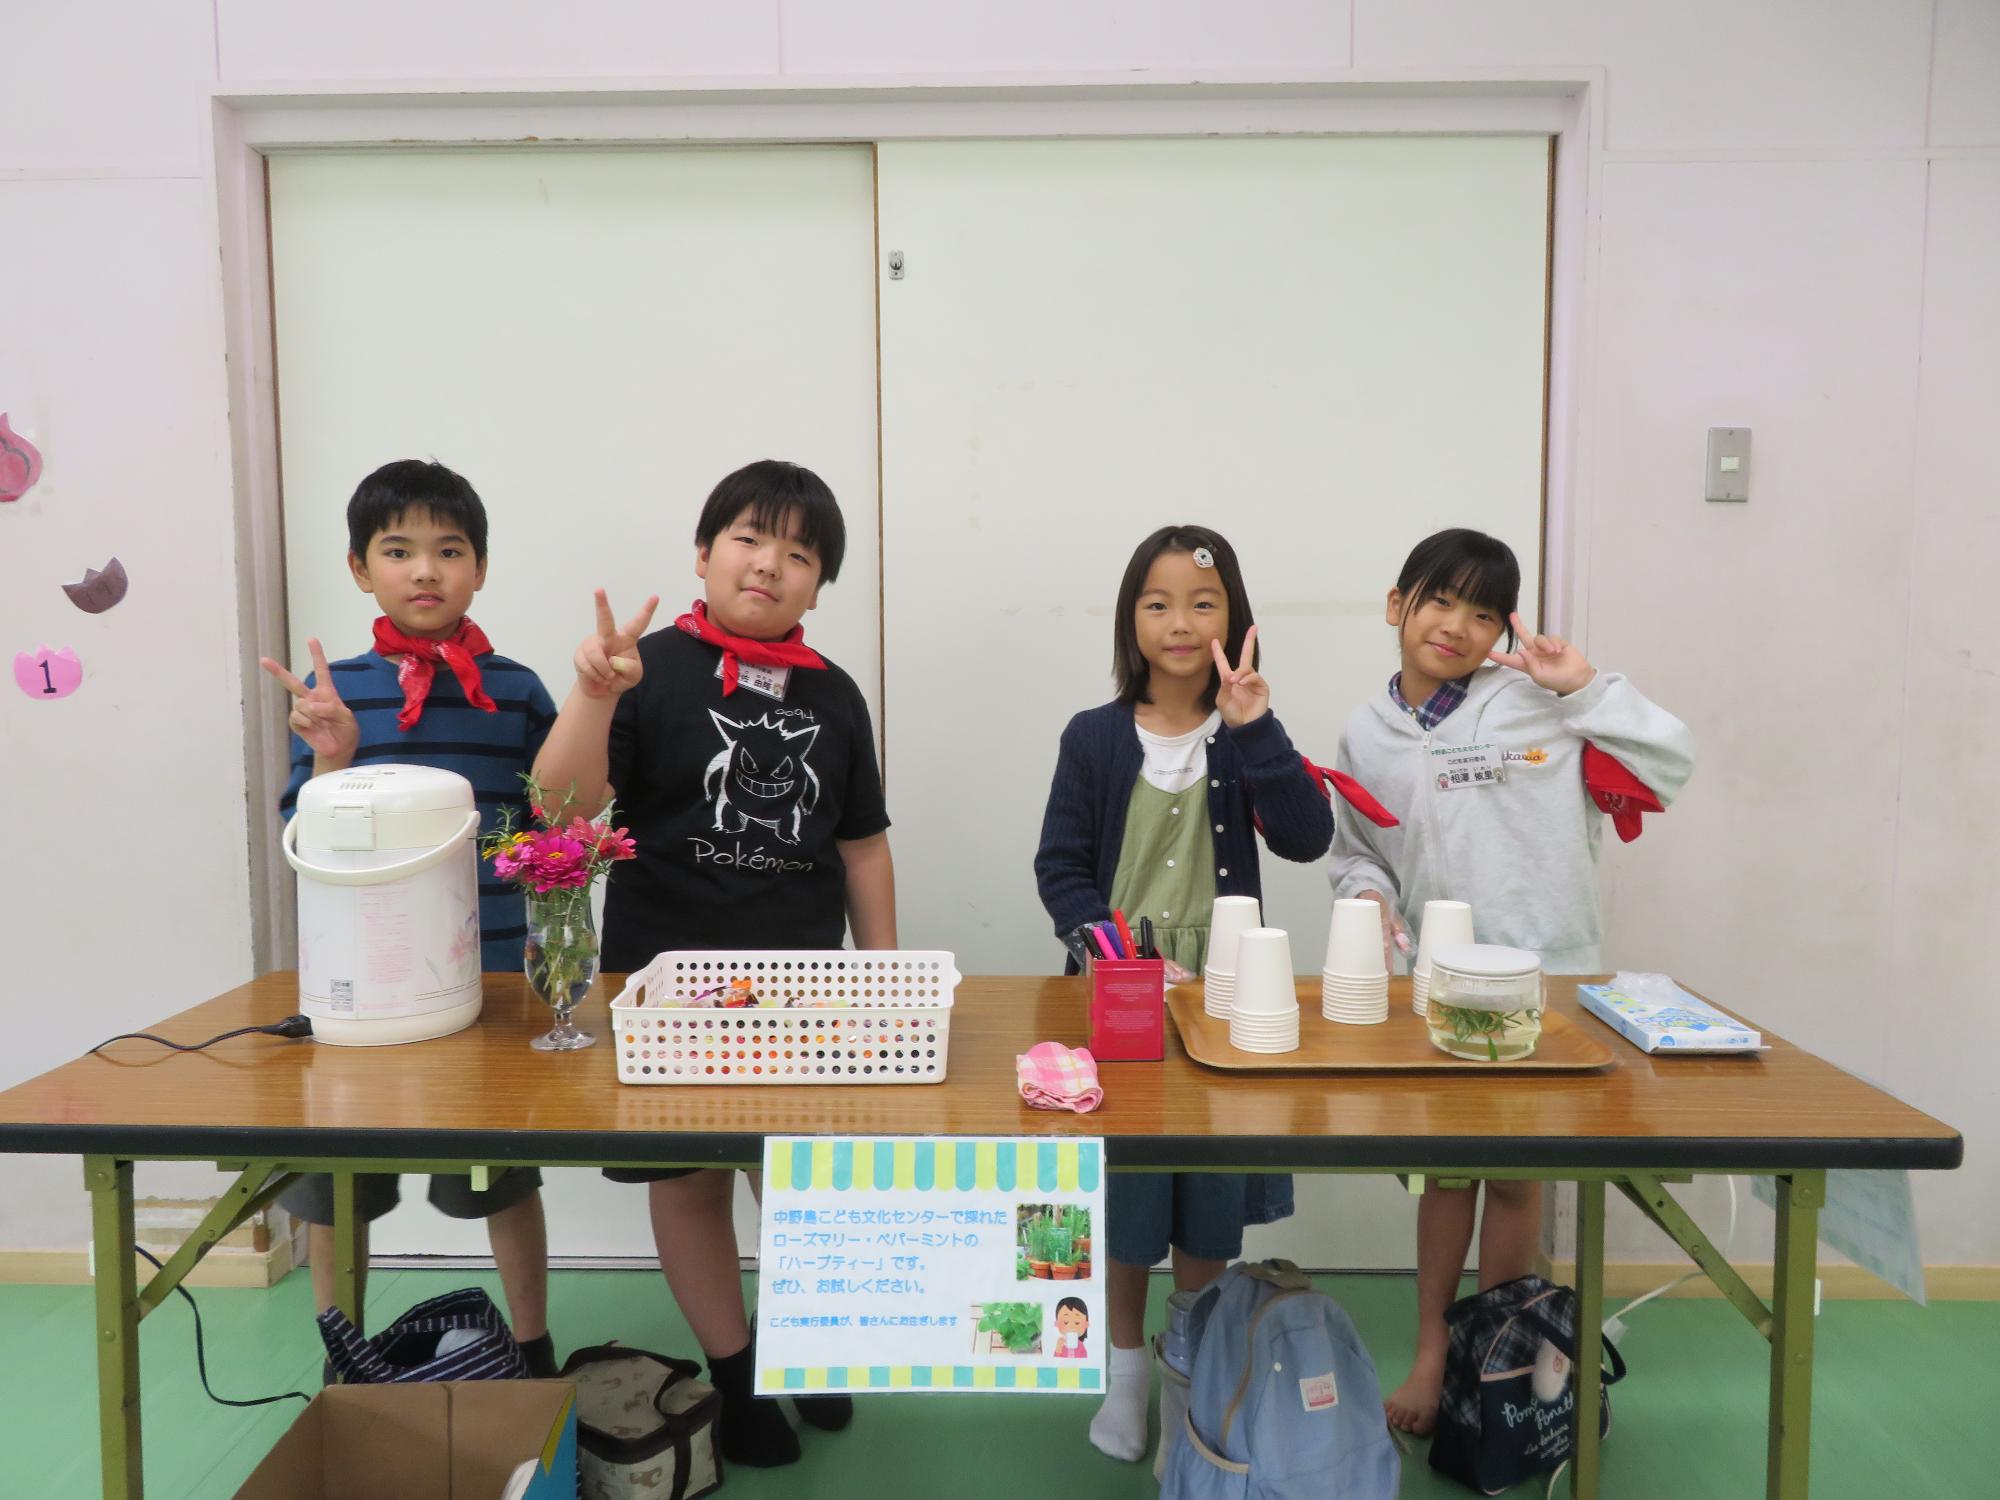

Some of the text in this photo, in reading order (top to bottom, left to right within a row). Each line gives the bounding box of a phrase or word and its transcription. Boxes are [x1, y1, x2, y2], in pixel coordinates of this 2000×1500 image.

[39, 659, 57, 694] 1
[775, 708, 815, 723] 0094
[687, 837, 813, 874] Pokémon
[772, 1208, 1009, 1226] 中野島こども文化センターで採れた
[773, 1231, 980, 1248] ローズマリー・ペパーミントの
